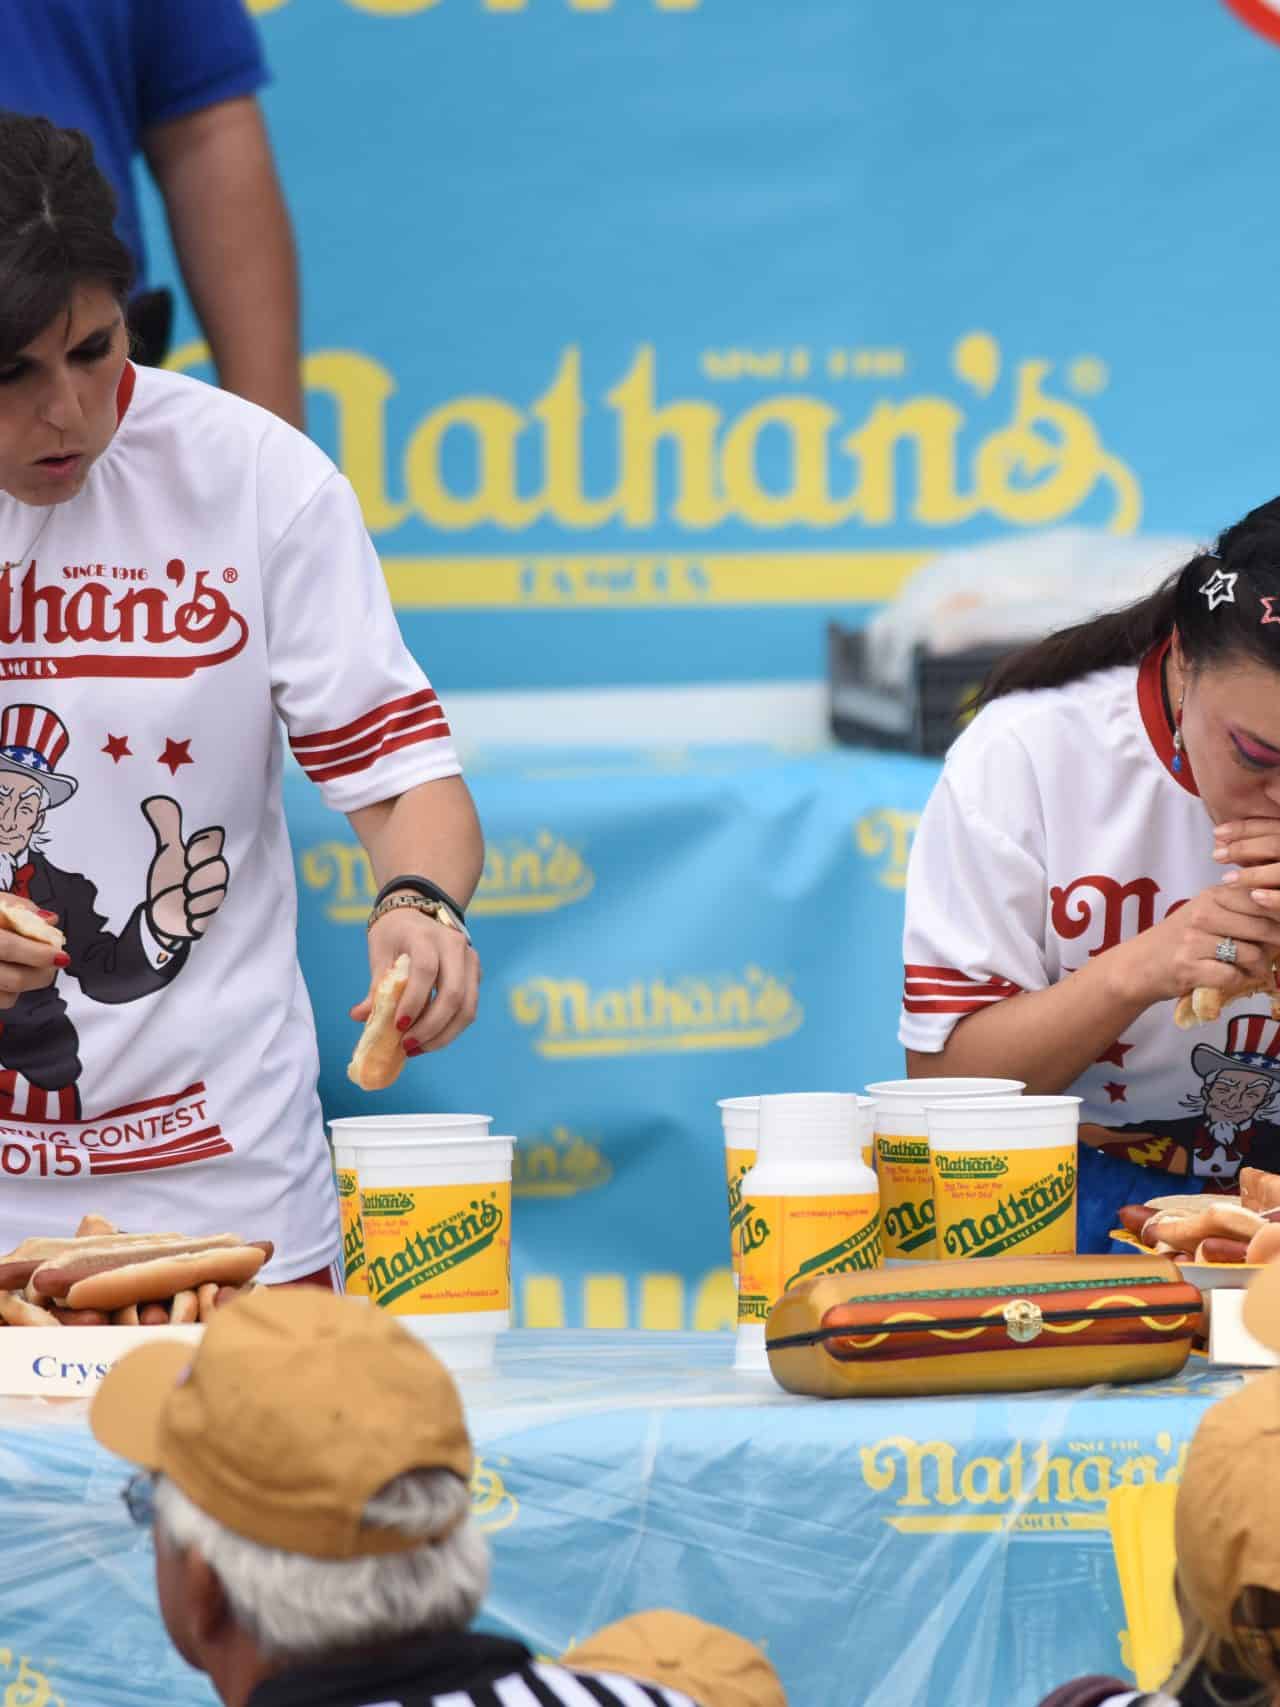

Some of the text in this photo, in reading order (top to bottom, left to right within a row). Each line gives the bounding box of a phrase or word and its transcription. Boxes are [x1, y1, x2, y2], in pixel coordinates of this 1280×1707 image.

[62, 564, 149, 581] SINCE 1916
[304, 828, 597, 904] Nan's
[511, 964, 802, 1040] Nathan's
[80, 1100, 207, 1148] CONTEST
[935, 1154, 1008, 1174] Nathan's
[368, 1199, 503, 1294] Nathan's
[944, 1162, 1076, 1257] Nathan's
[32, 1355, 112, 1385] Crys
[858, 1431, 1192, 1507] Natha'
